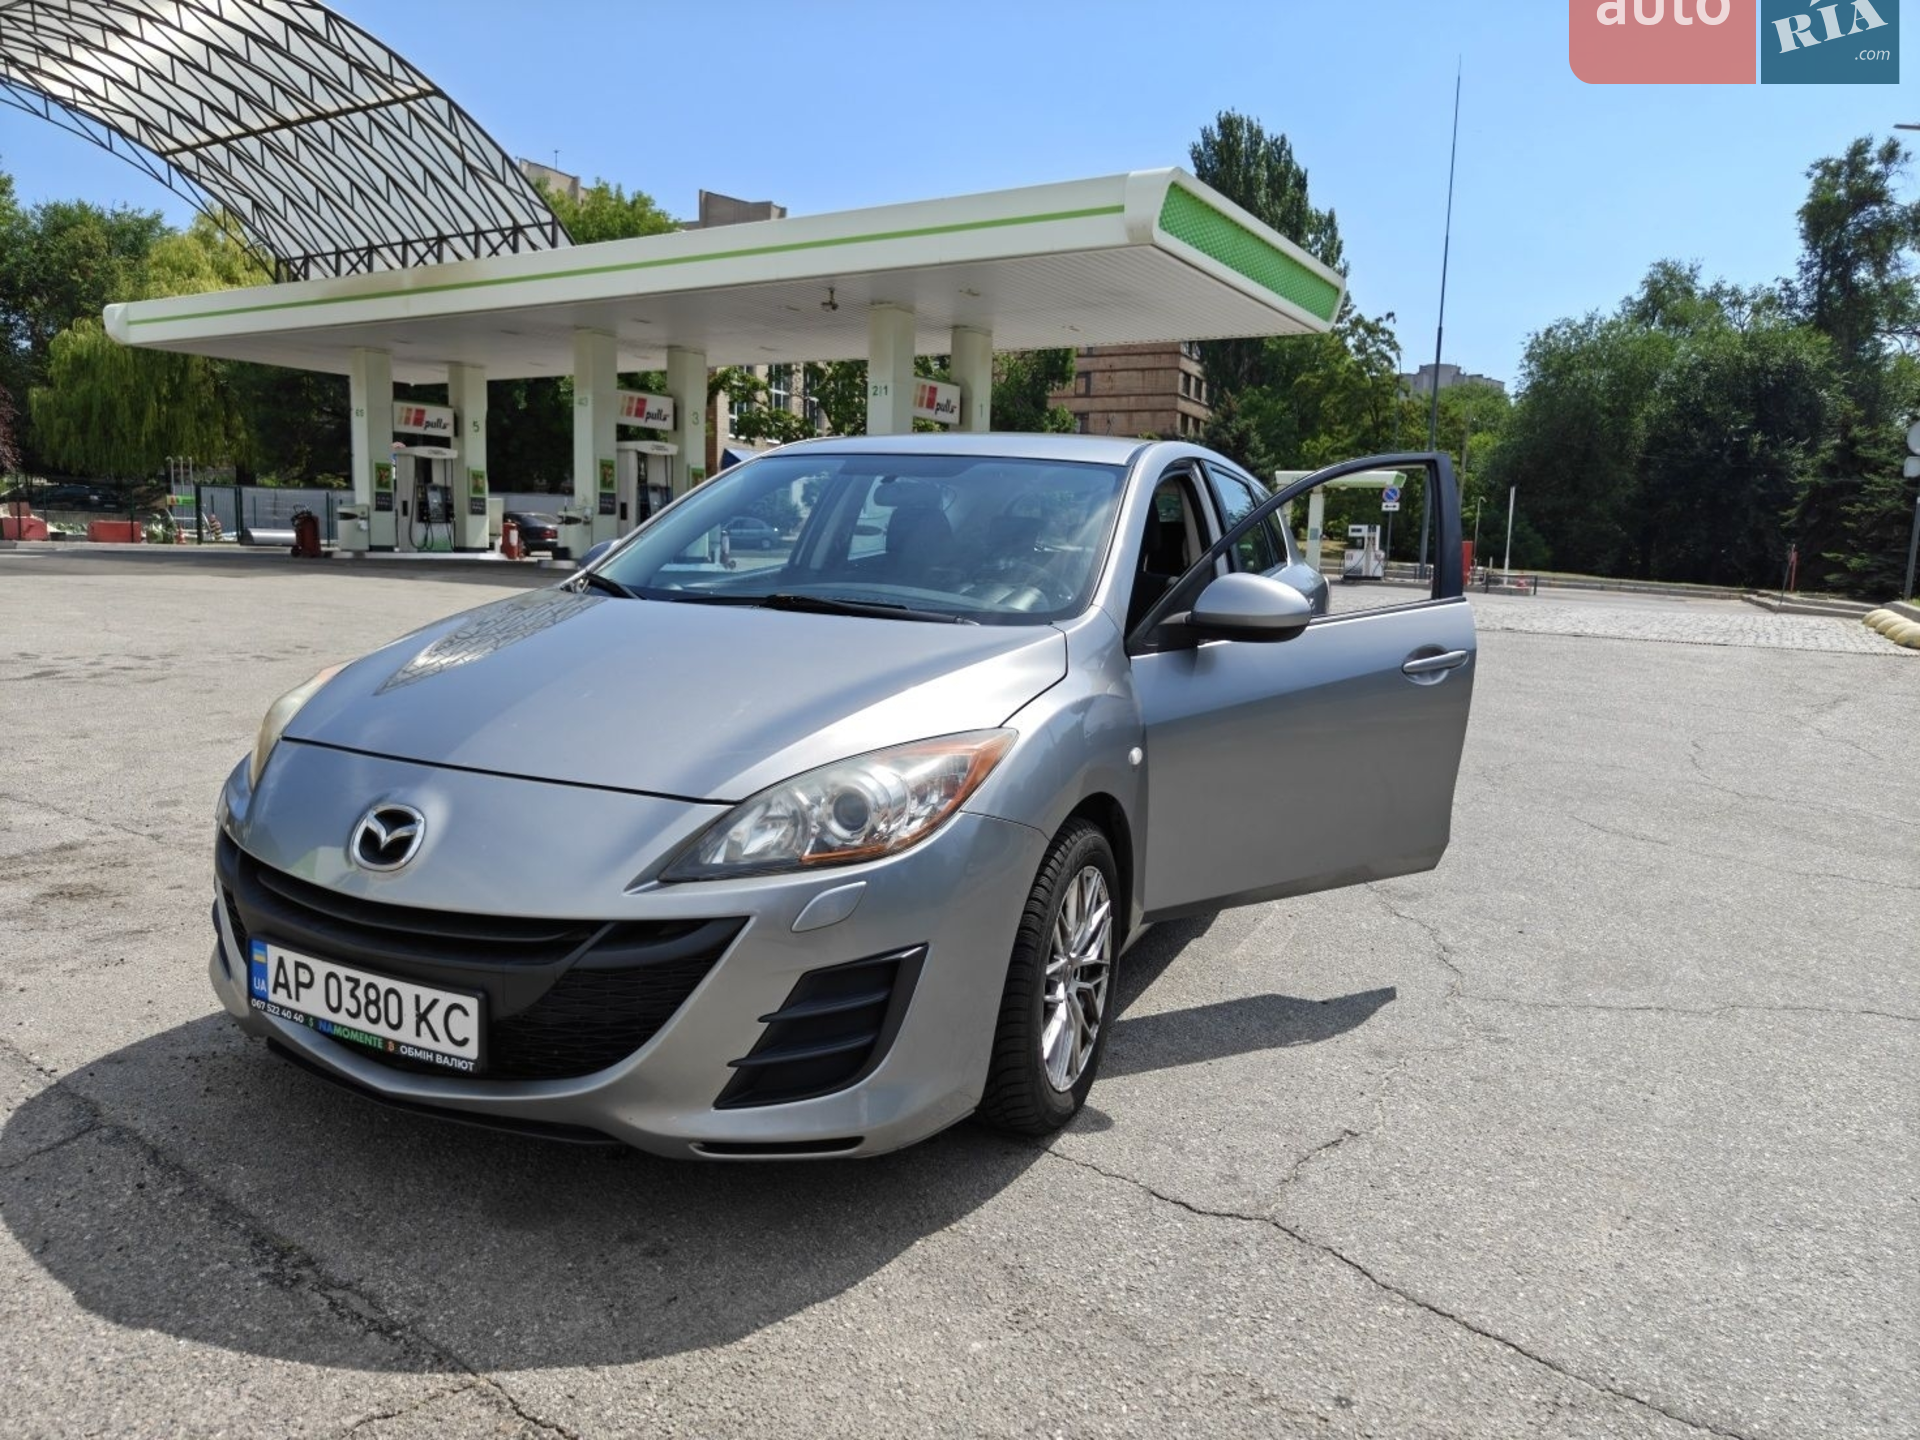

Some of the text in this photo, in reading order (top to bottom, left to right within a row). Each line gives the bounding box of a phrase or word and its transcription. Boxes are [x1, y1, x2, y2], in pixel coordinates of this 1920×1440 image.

[691, 411, 700, 425] 3
[472, 420, 480, 433] 5
[253, 977, 267, 993] UA
[272, 955, 470, 1047] AP 0380 KC
[251, 998, 266, 1011] 067
[266, 1003, 280, 1016] 522
[281, 1008, 292, 1020] 40
[293, 1013, 304, 1024] 40
[400, 1045, 433, 1061] ОБМІН
[435, 1053, 475, 1072] ВАЛЮТ
